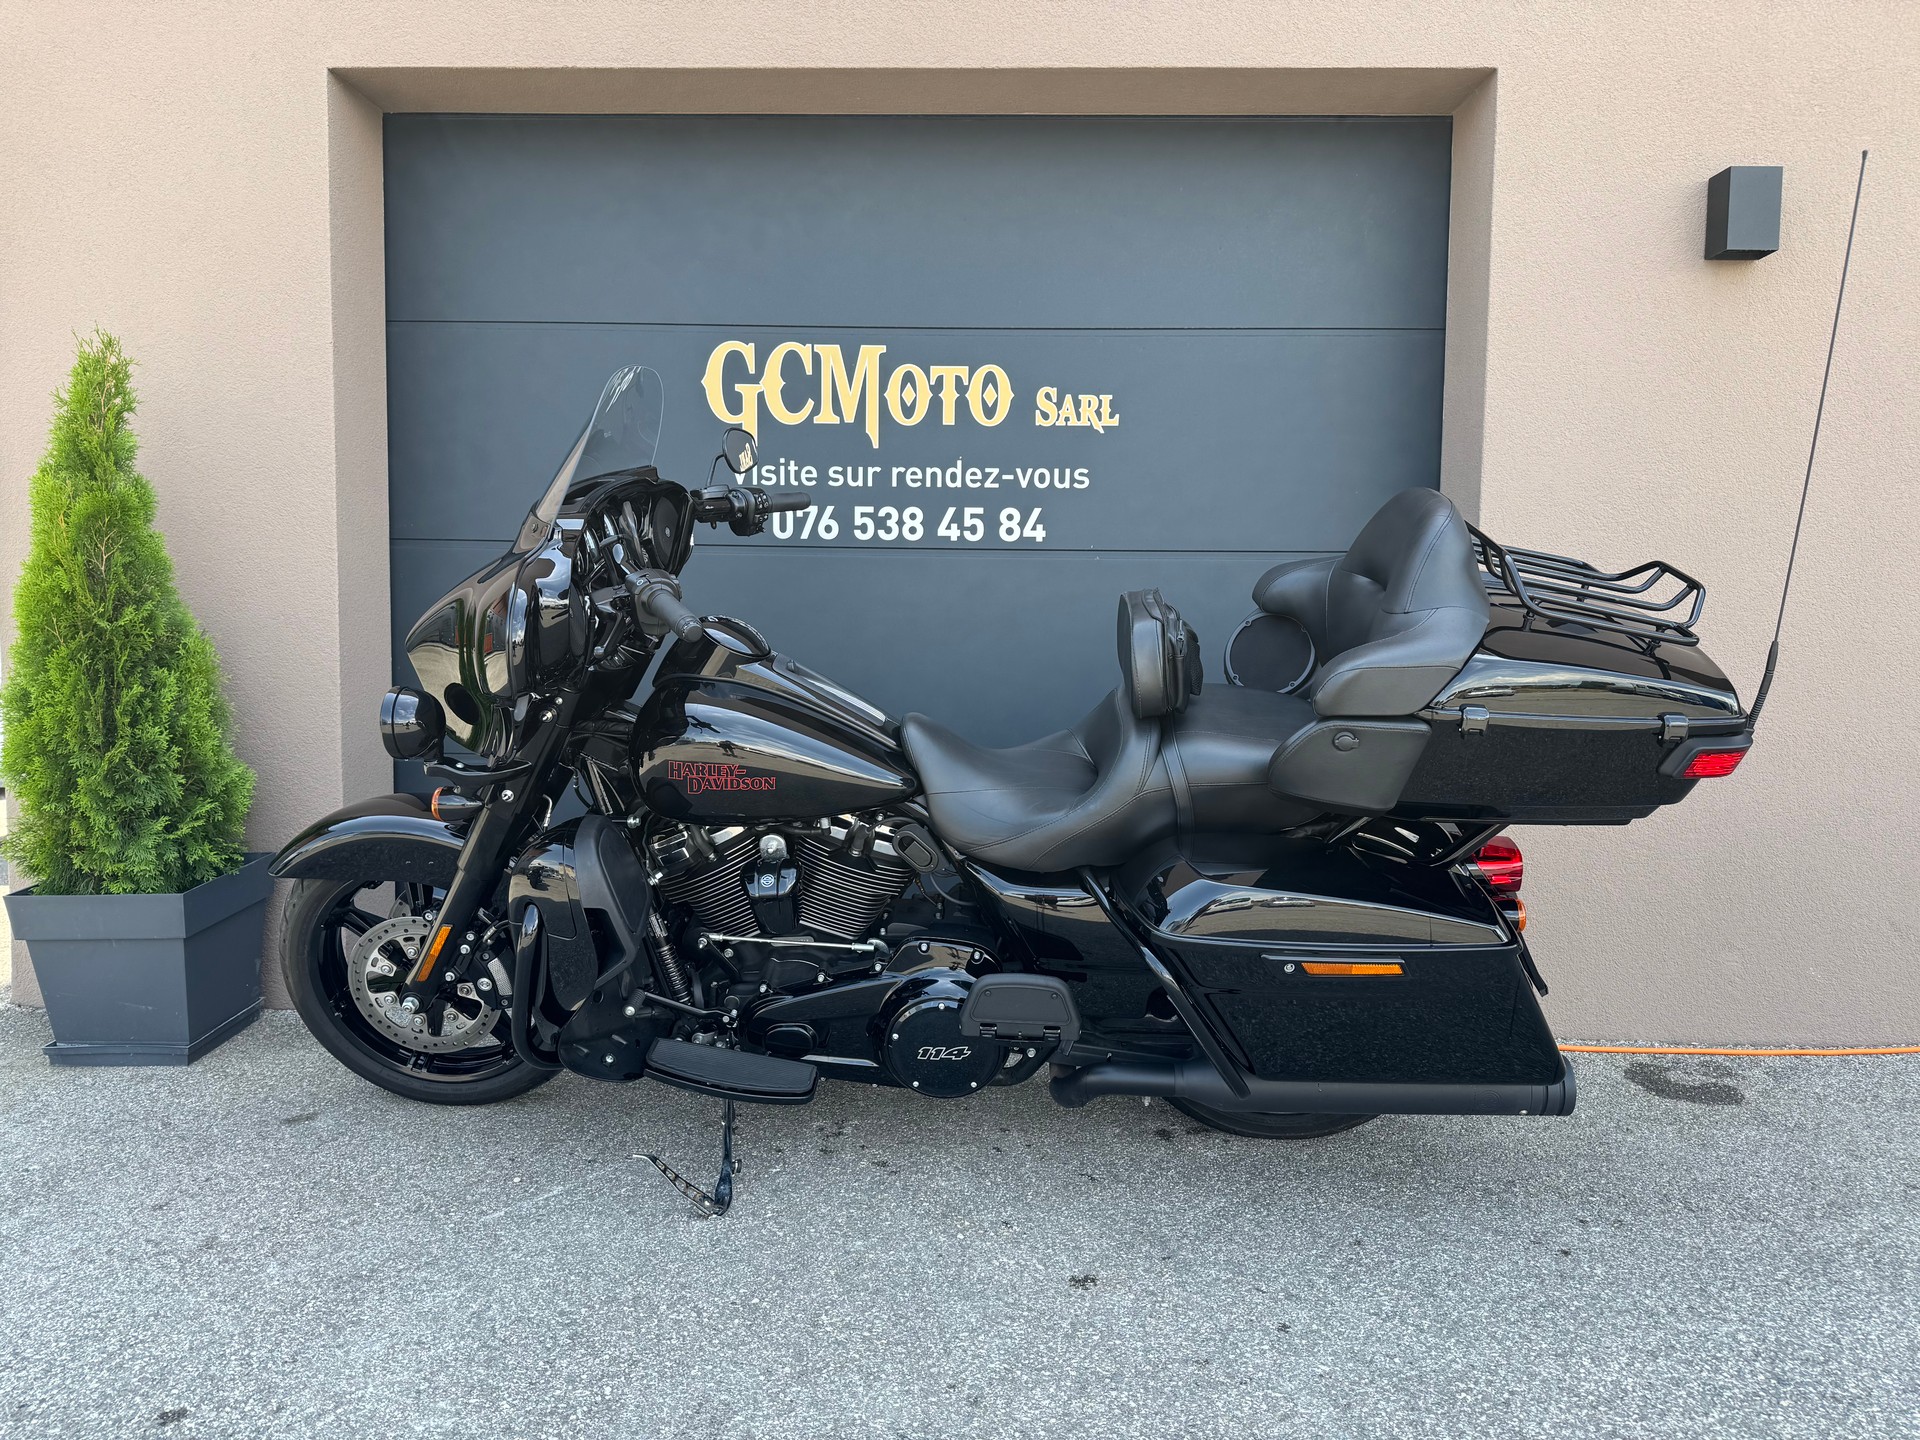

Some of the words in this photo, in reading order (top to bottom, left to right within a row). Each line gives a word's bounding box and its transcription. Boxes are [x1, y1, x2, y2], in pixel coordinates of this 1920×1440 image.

[827, 466, 882, 488] sur
[891, 460, 1090, 489] rendez-vous
[772, 506, 840, 540] 076
[853, 506, 924, 542] 538
[938, 507, 985, 542] 45
[998, 508, 1047, 543] 84
[687, 776, 776, 794] DAVIDSON
[917, 1046, 971, 1060] 114
